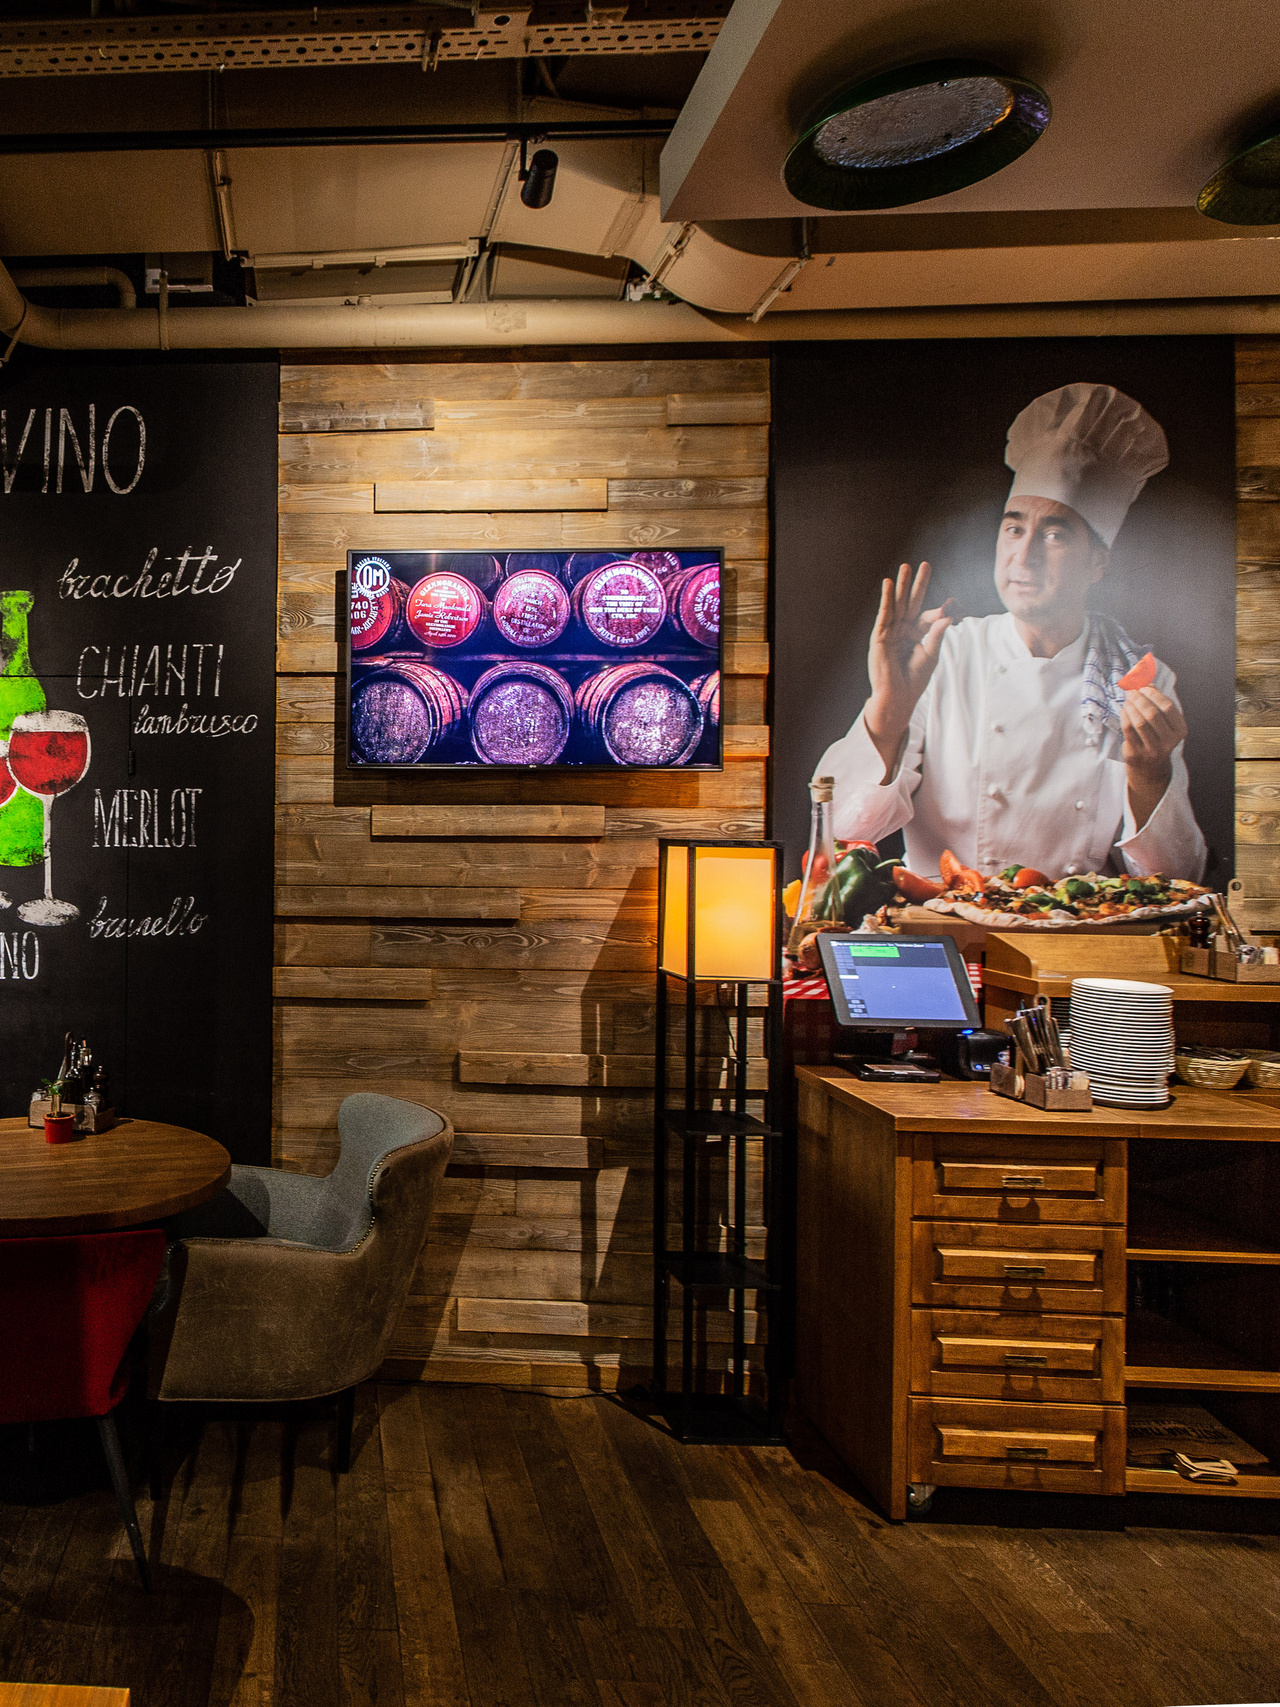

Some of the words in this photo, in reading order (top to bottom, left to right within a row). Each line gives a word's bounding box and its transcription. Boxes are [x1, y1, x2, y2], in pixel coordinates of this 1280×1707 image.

[0, 403, 147, 495] VINO
[57, 545, 242, 600] brachetto
[362, 565, 384, 589] OM
[76, 643, 224, 699] CHIANTI
[133, 703, 259, 737] lambrusco
[92, 788, 203, 848] MERLOT
[87, 895, 208, 938] brunello
